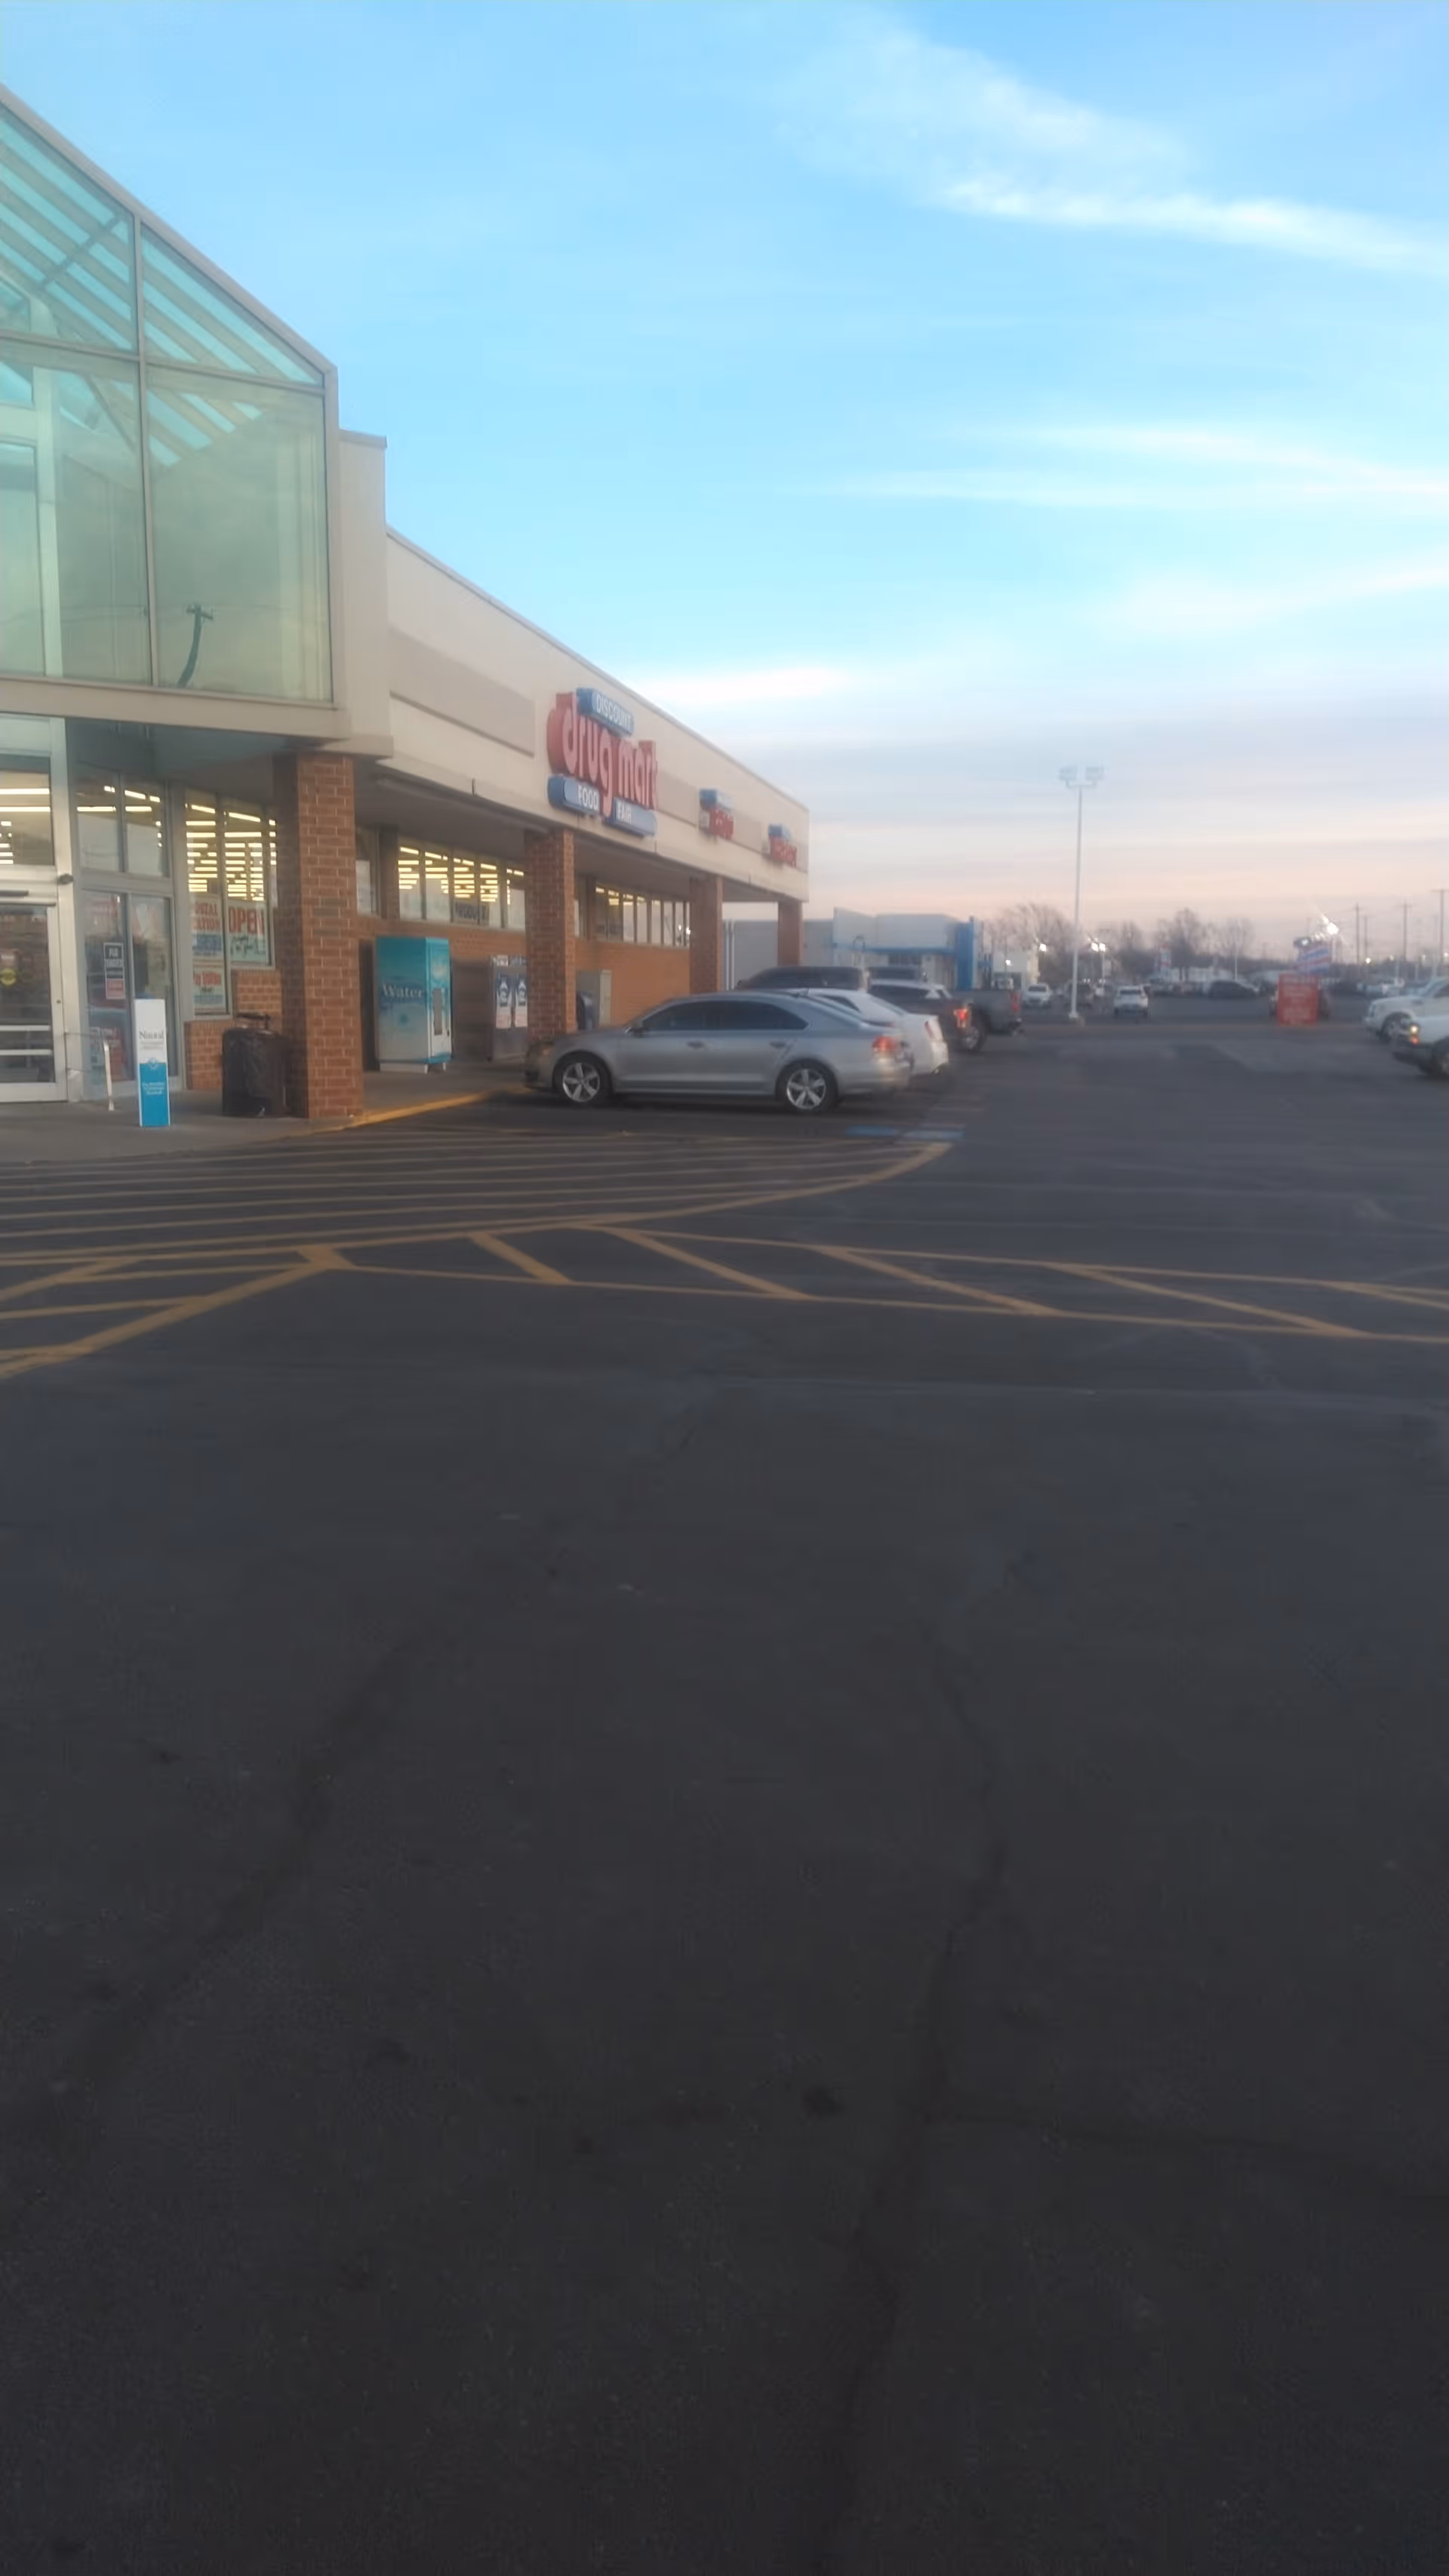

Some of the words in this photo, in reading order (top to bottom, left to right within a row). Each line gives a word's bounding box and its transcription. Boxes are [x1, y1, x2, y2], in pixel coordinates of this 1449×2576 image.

[595, 693, 632, 729] DISCOUNT
[557, 693, 613, 817] drug
[617, 739, 658, 811] mart
[577, 784, 598, 811] FOOD
[616, 801, 632, 823] FAIR
[383, 983, 424, 999] Water
